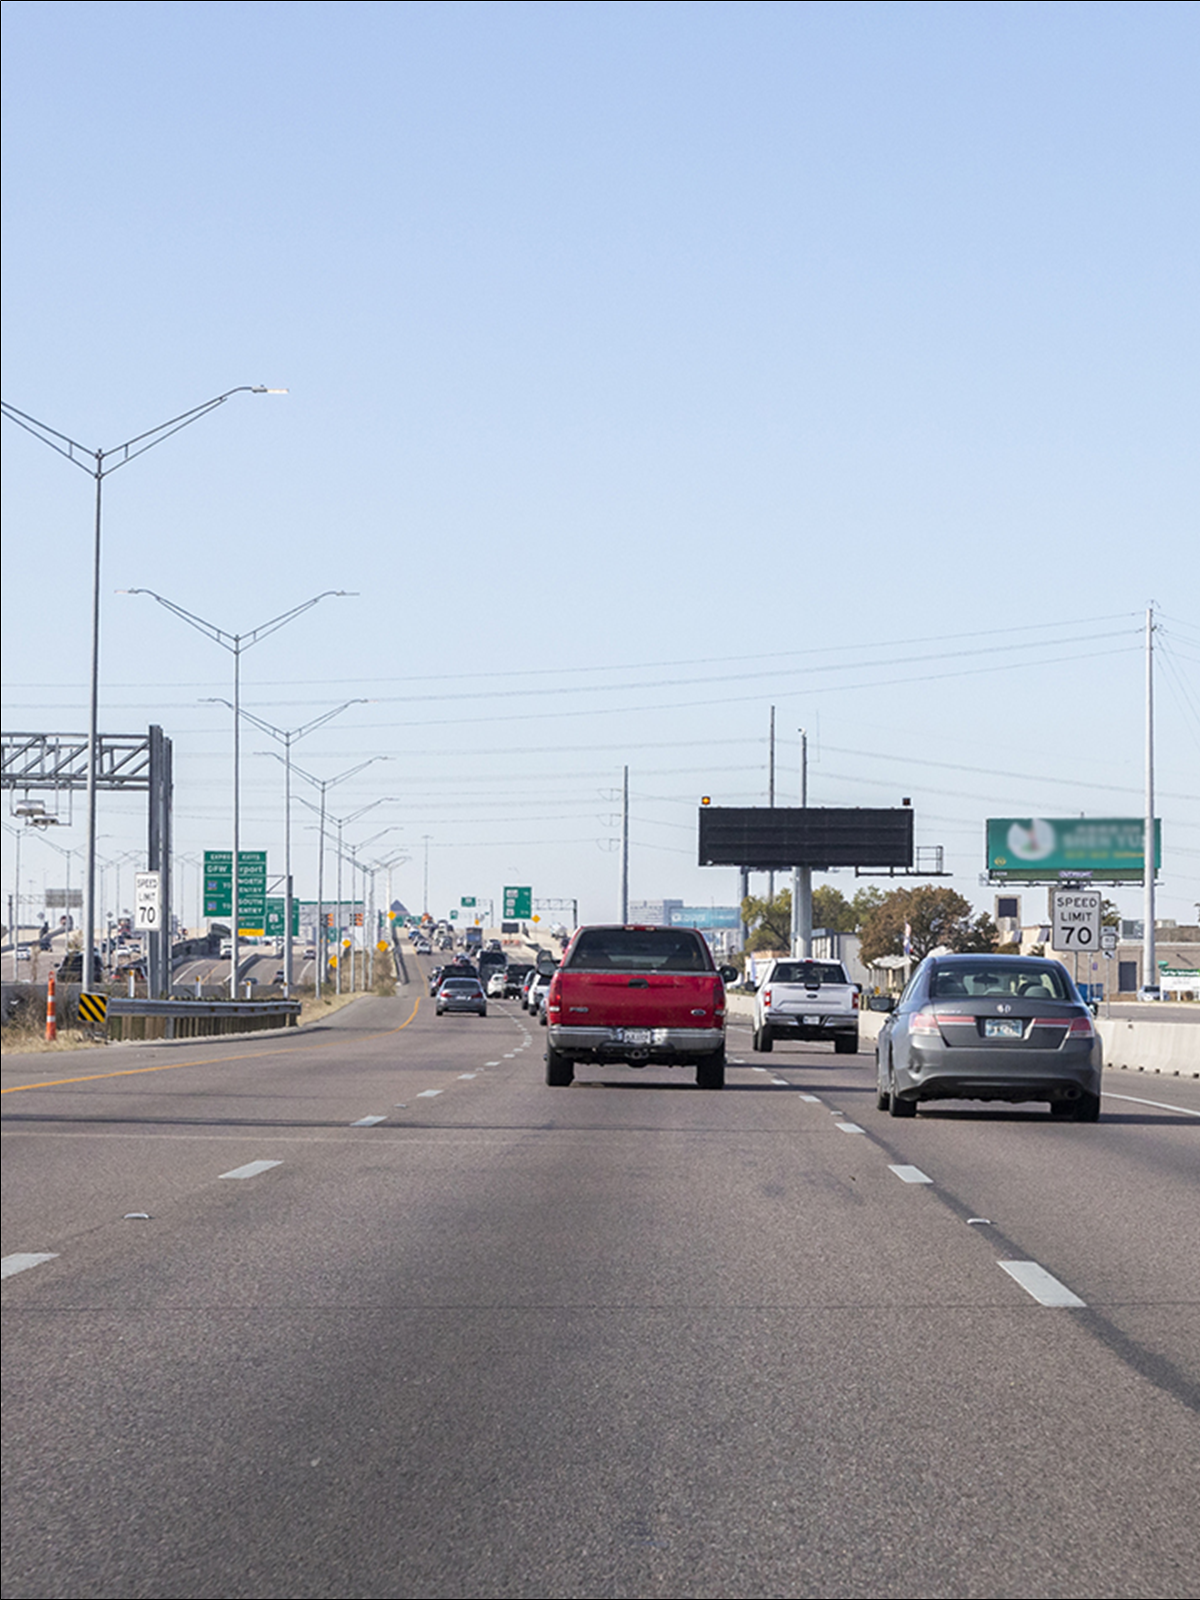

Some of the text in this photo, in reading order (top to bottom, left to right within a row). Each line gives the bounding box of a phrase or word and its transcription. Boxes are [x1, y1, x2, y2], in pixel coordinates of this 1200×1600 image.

[1057, 896, 1098, 908] SPEED
[139, 906, 156, 923] 70
[1060, 912, 1092, 921] LIMIT
[1061, 926, 1092, 945] 70
